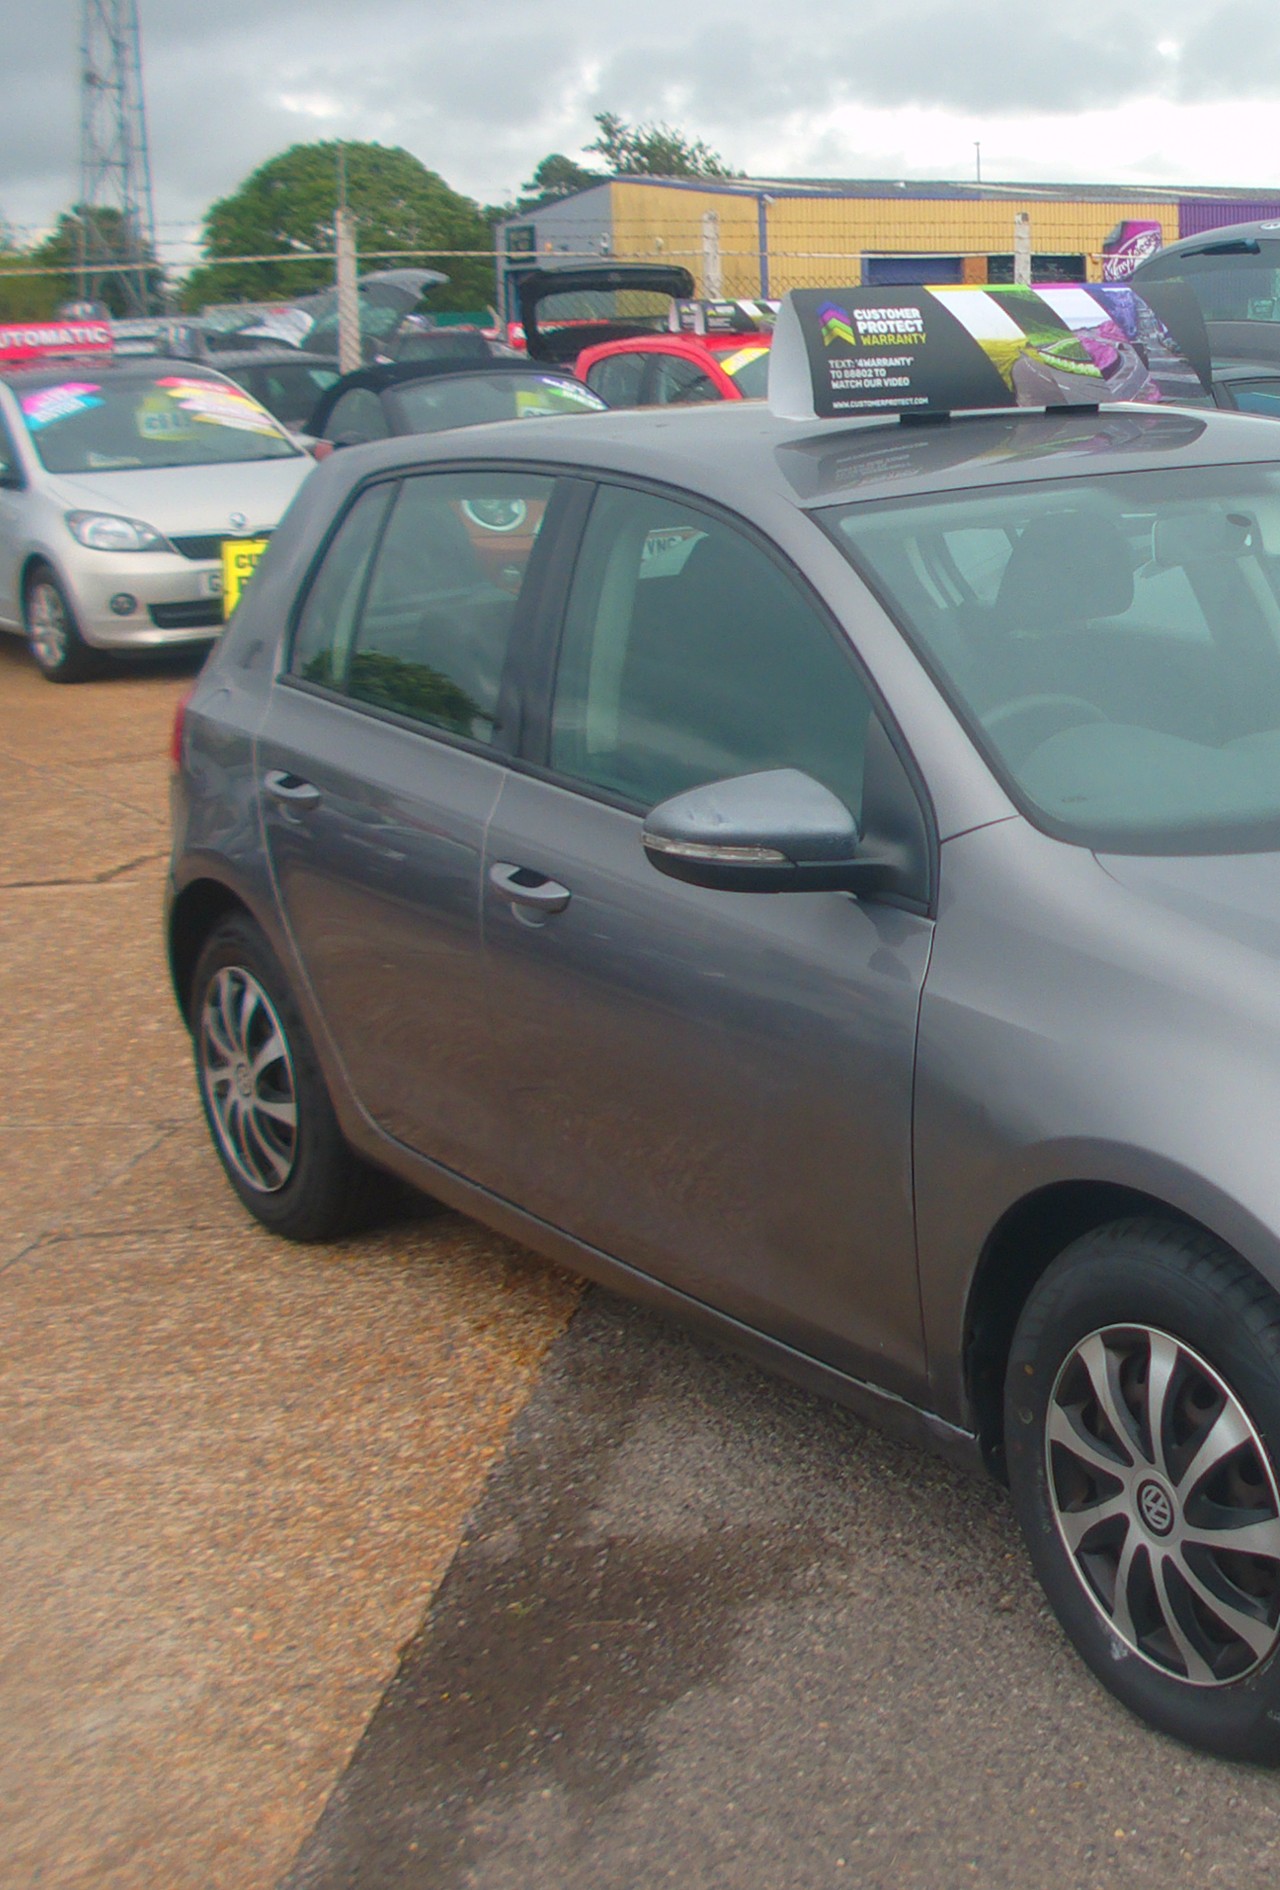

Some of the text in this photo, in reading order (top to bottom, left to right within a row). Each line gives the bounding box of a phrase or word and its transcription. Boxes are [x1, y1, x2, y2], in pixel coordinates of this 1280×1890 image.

[853, 308, 921, 320] CUSTOMER
[856, 319, 924, 333] PROTECT
[0, 327, 110, 349] UTOMATIC
[861, 333, 926, 345] WARRANTY
[830, 370, 842, 379] TO
[874, 368, 887, 377] TO
[831, 377, 910, 389] WATCH OUR VIDEO
